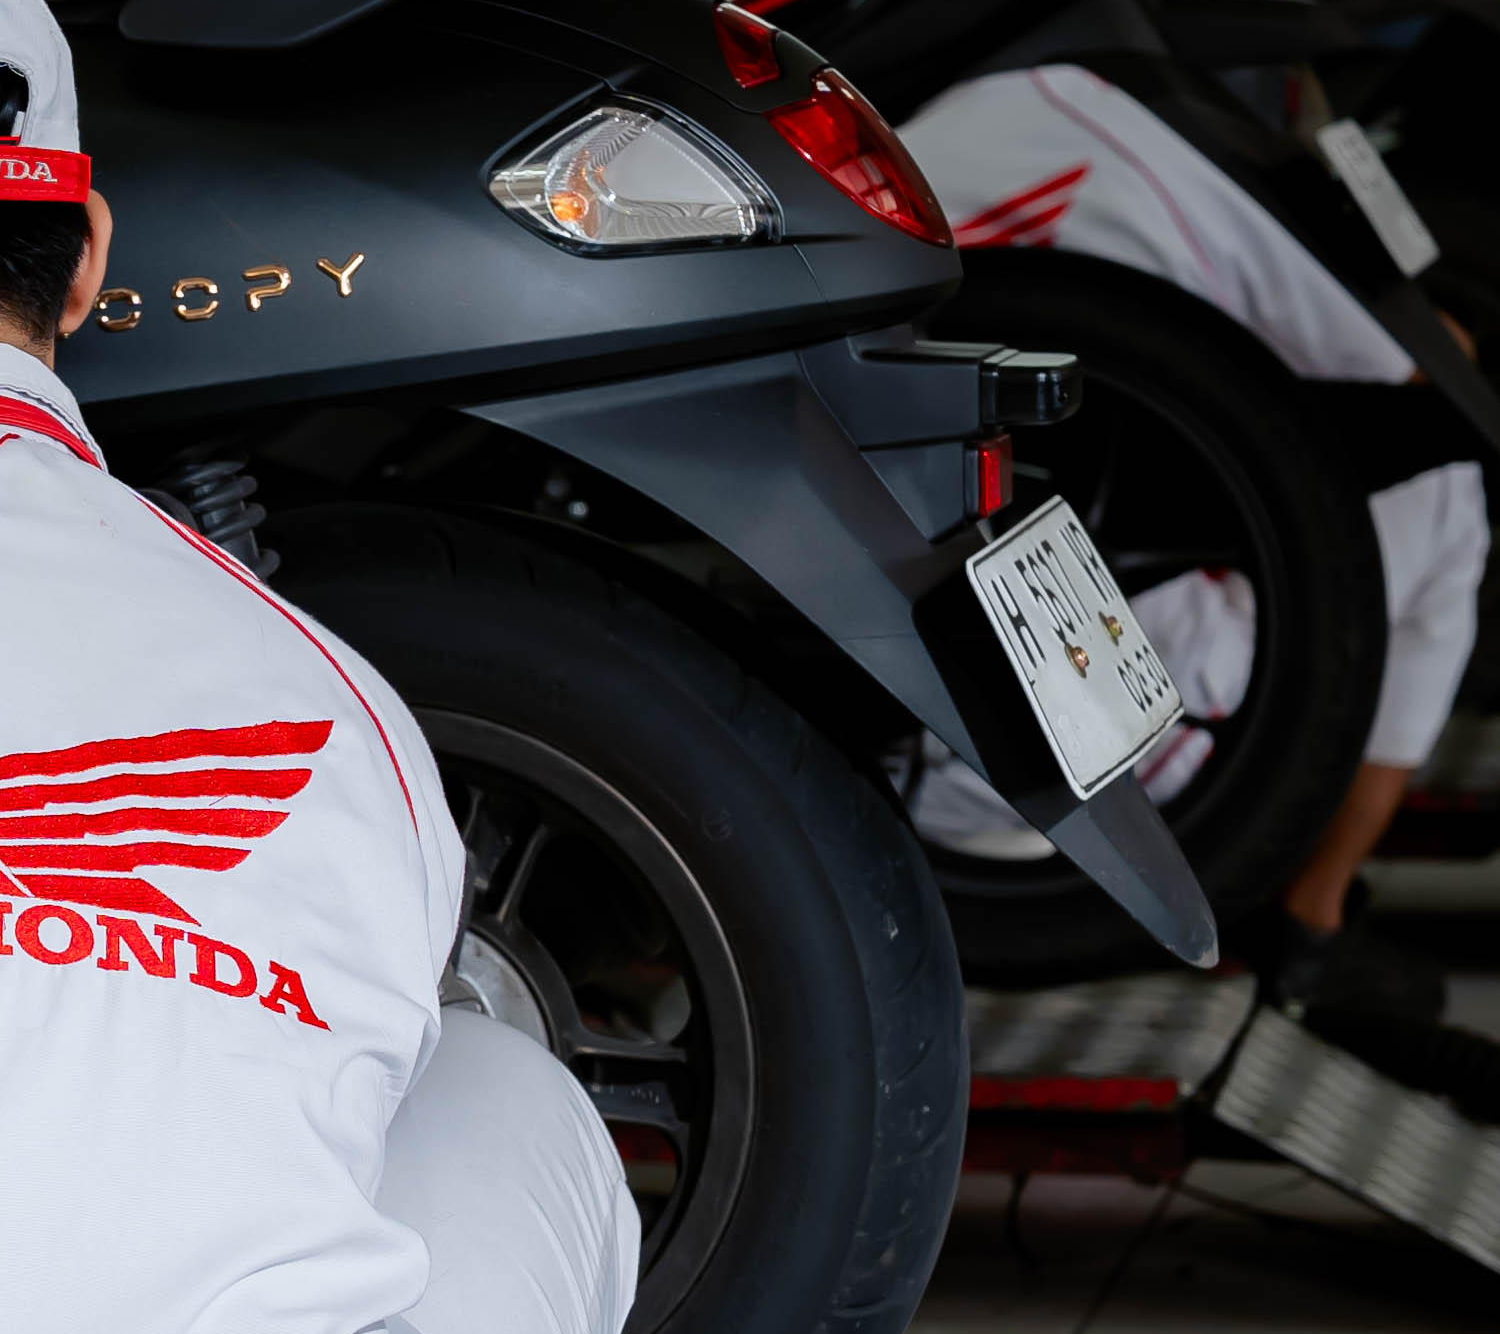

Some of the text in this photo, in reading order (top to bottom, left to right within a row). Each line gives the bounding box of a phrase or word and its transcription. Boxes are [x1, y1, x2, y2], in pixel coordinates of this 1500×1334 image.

[94, 251, 366, 333] OOPY
[991, 574, 1046, 670] H
[1014, 539, 1092, 645] 5617
